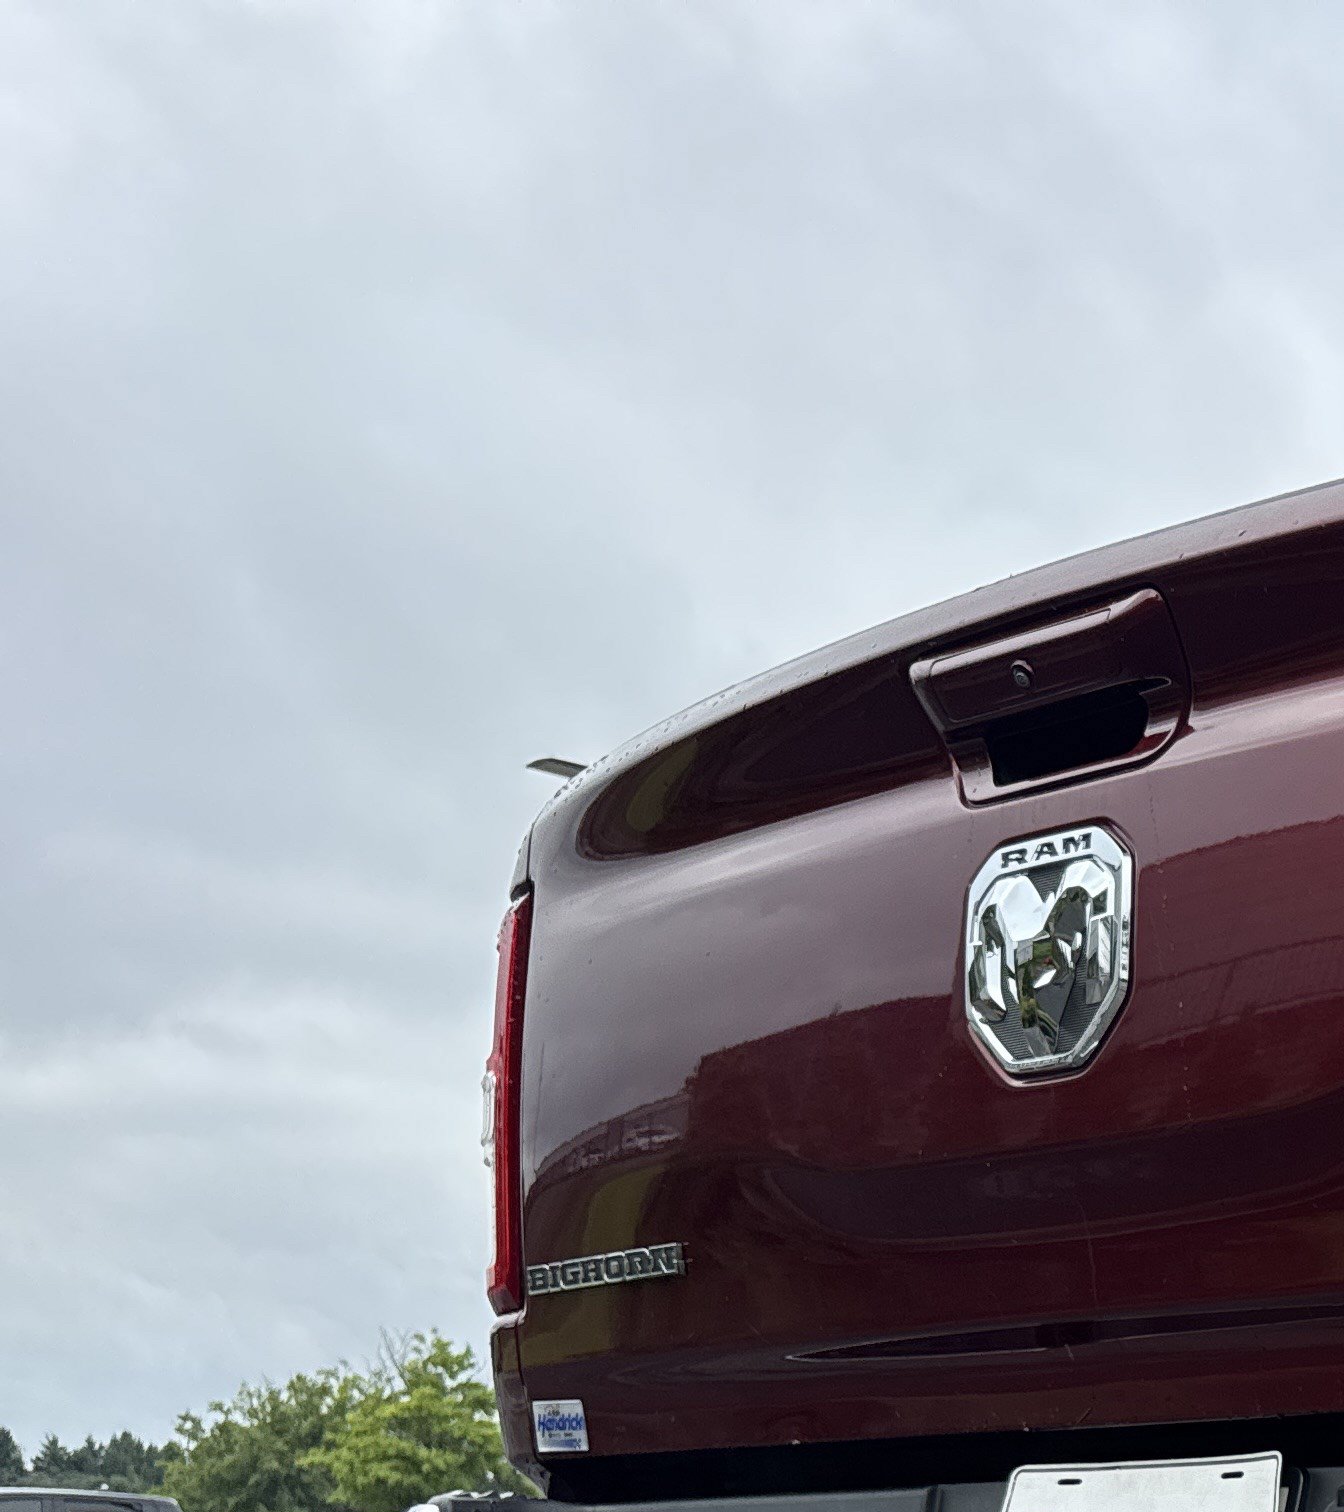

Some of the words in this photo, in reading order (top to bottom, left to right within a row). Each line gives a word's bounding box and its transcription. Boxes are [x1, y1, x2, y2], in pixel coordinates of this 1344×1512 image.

[1001, 832, 1093, 868] RAM
[527, 1242, 684, 1296] BIGHORN
[537, 1413, 584, 1438] Hendrick
